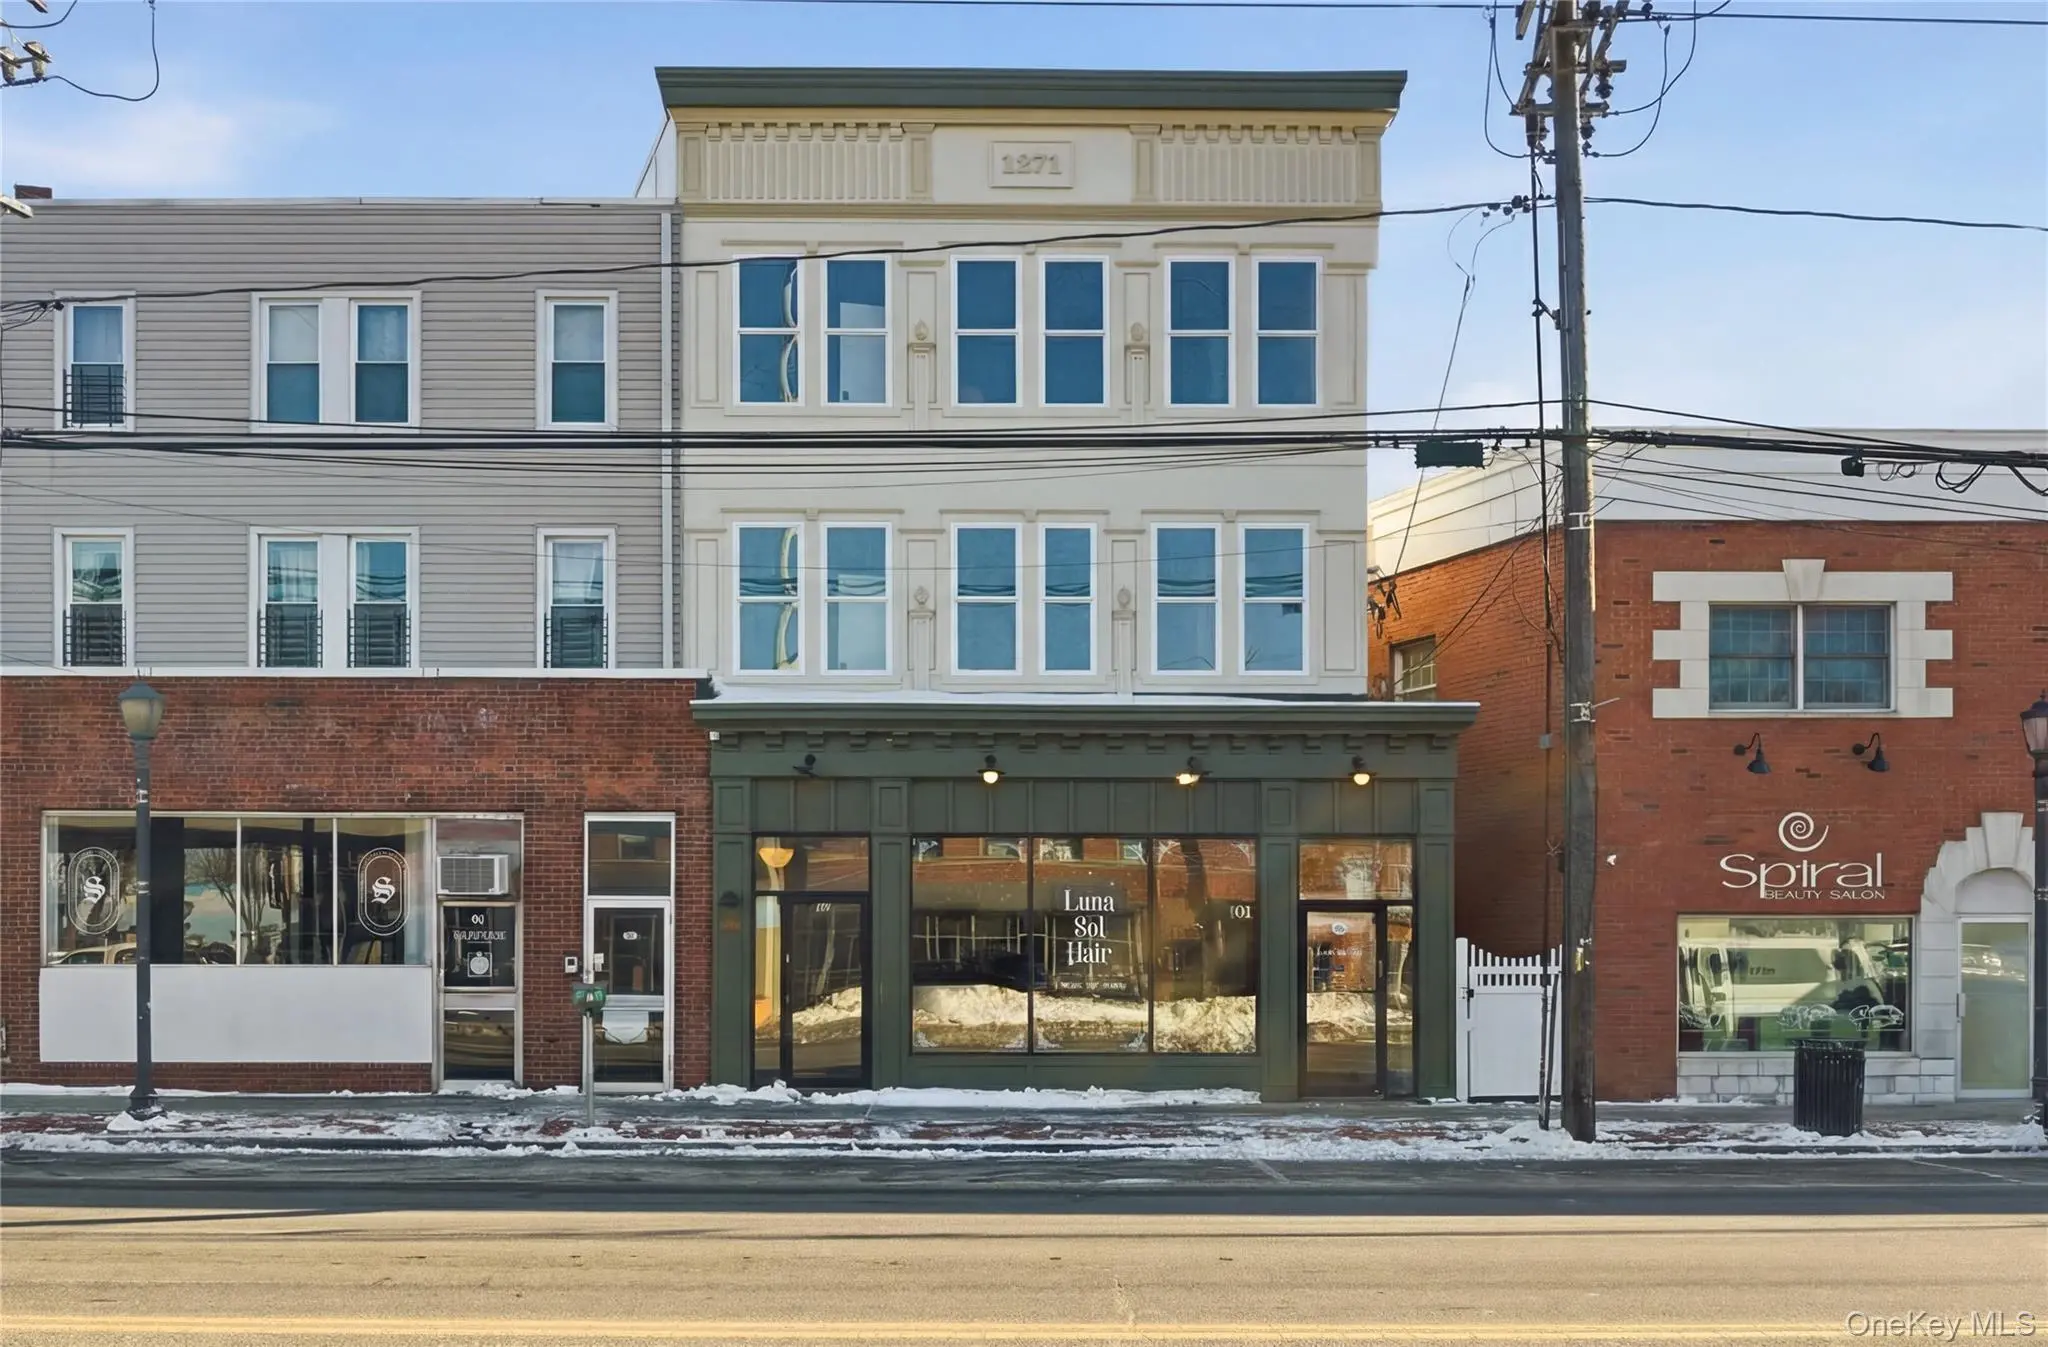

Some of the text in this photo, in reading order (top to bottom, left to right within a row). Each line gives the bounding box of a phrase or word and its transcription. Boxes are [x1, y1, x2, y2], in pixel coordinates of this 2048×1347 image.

[1001, 152, 1063, 175] 1271
[1719, 854, 1882, 899] Spiral
[1064, 889, 1115, 912] Luna
[1764, 889, 1885, 900] BEAUTY SALON
[1074, 915, 1107, 938] Sol
[1066, 941, 1112, 966] Hair
